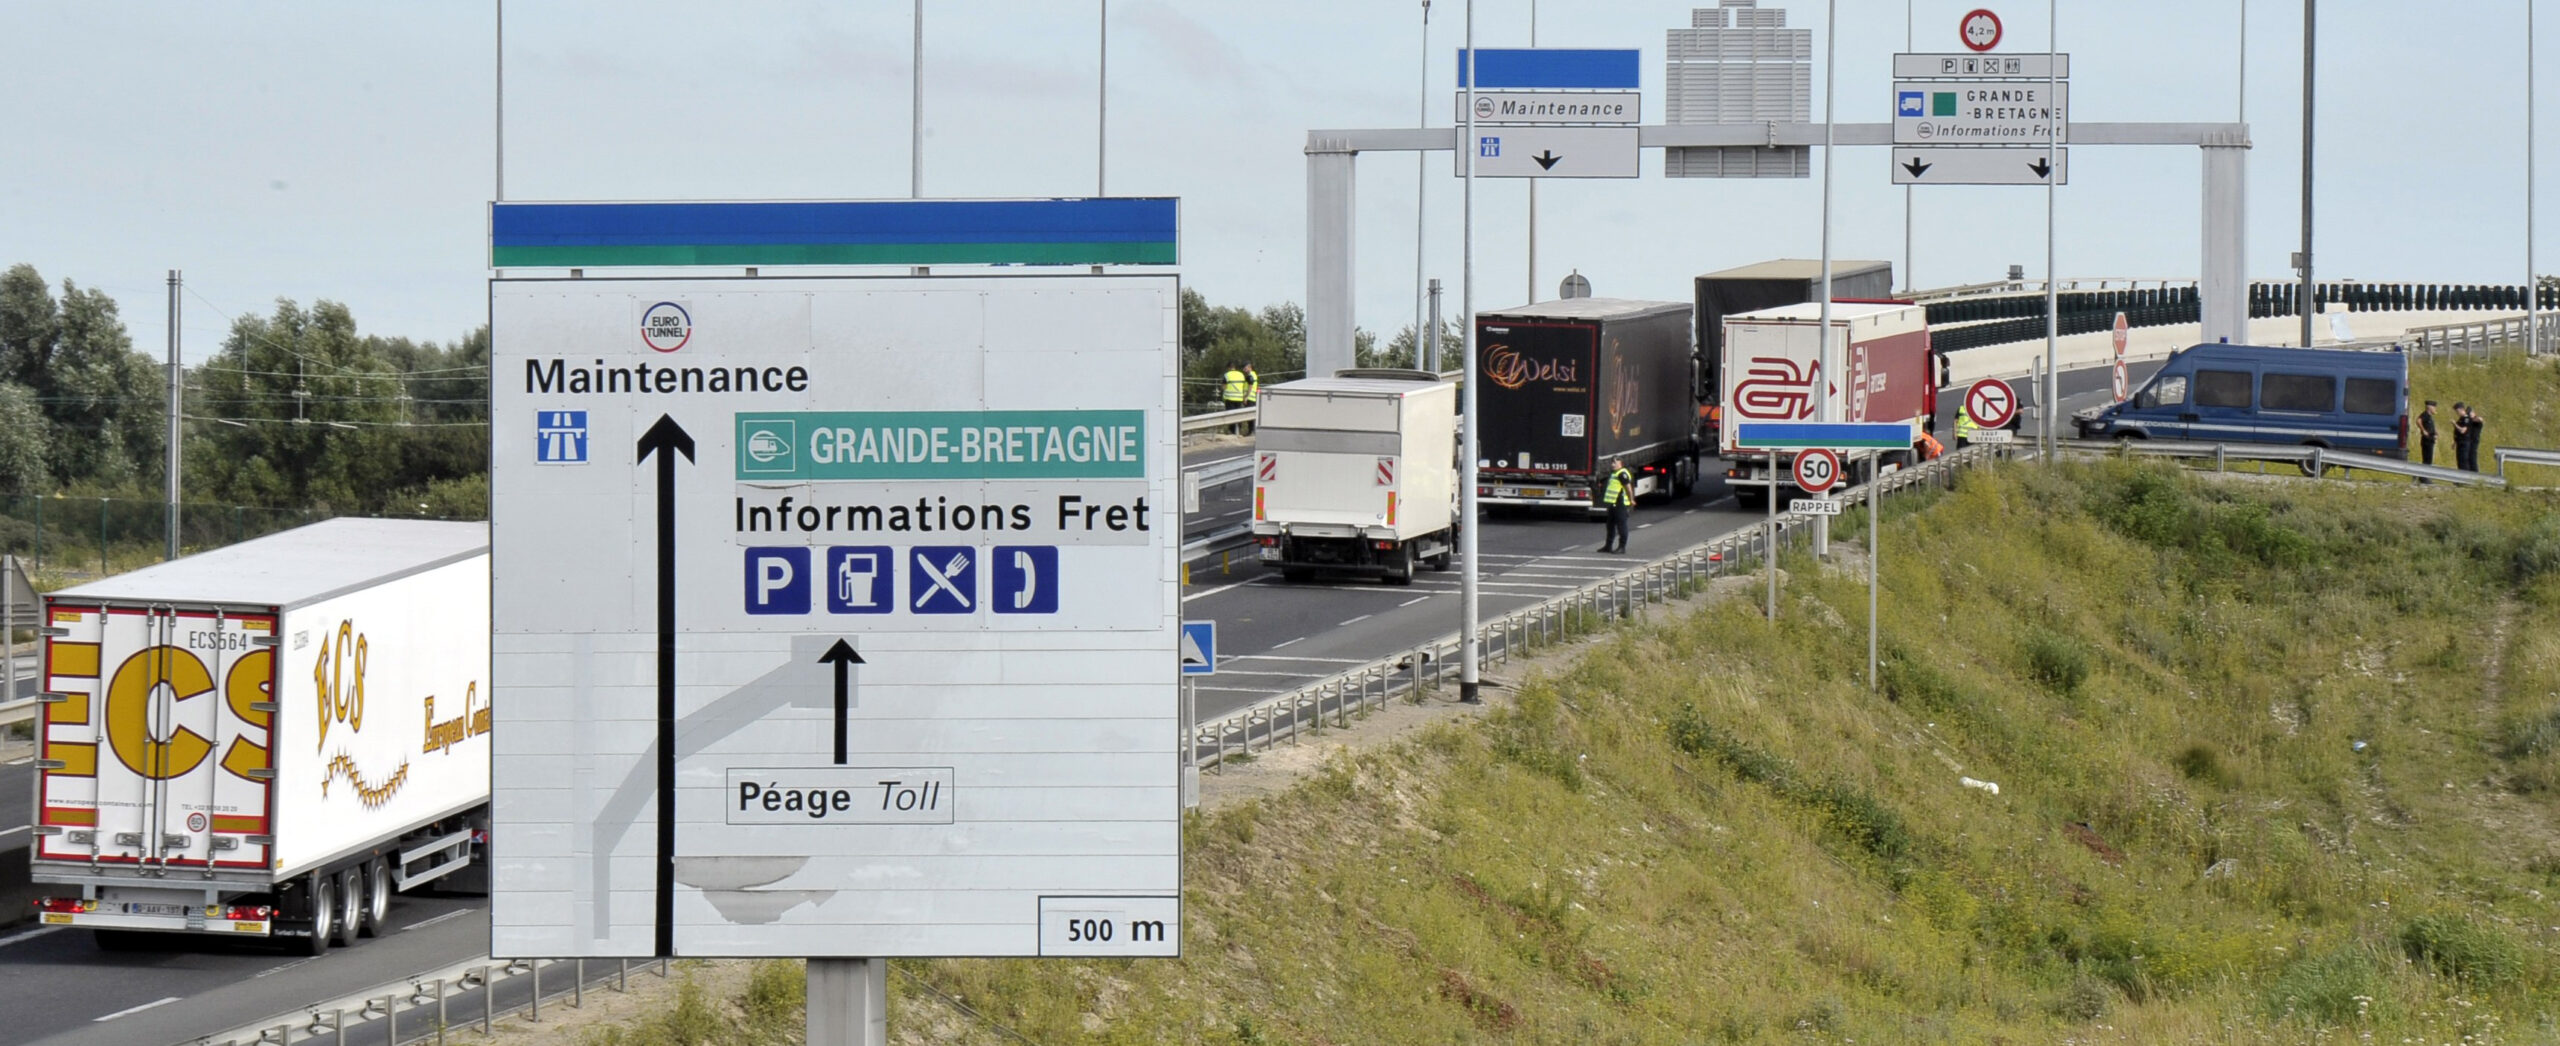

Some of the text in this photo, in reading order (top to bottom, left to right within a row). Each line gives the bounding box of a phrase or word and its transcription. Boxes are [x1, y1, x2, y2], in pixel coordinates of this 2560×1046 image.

[1944, 60, 1954, 71] P
[1501, 100, 1623, 115] Maintenance
[1966, 90, 2035, 102] GRANDE
[1936, 124, 2026, 137] Informations
[646, 327, 685, 338] TUNNEL
[652, 316, 679, 327] EURO
[525, 358, 809, 394] Maintenance
[810, 426, 1137, 464] GRANDE-BRETAGNE
[1803, 460, 1830, 479] 50
[736, 495, 1150, 532] Informations Fret
[1792, 501, 1837, 513] RAPPEL
[757, 557, 794, 605] P
[313, 618, 368, 758] ECS
[46, 641, 272, 784] ECS
[423, 694, 464, 756] European
[739, 781, 940, 818] Péage Toll
[1068, 918, 1166, 942] 500 m
